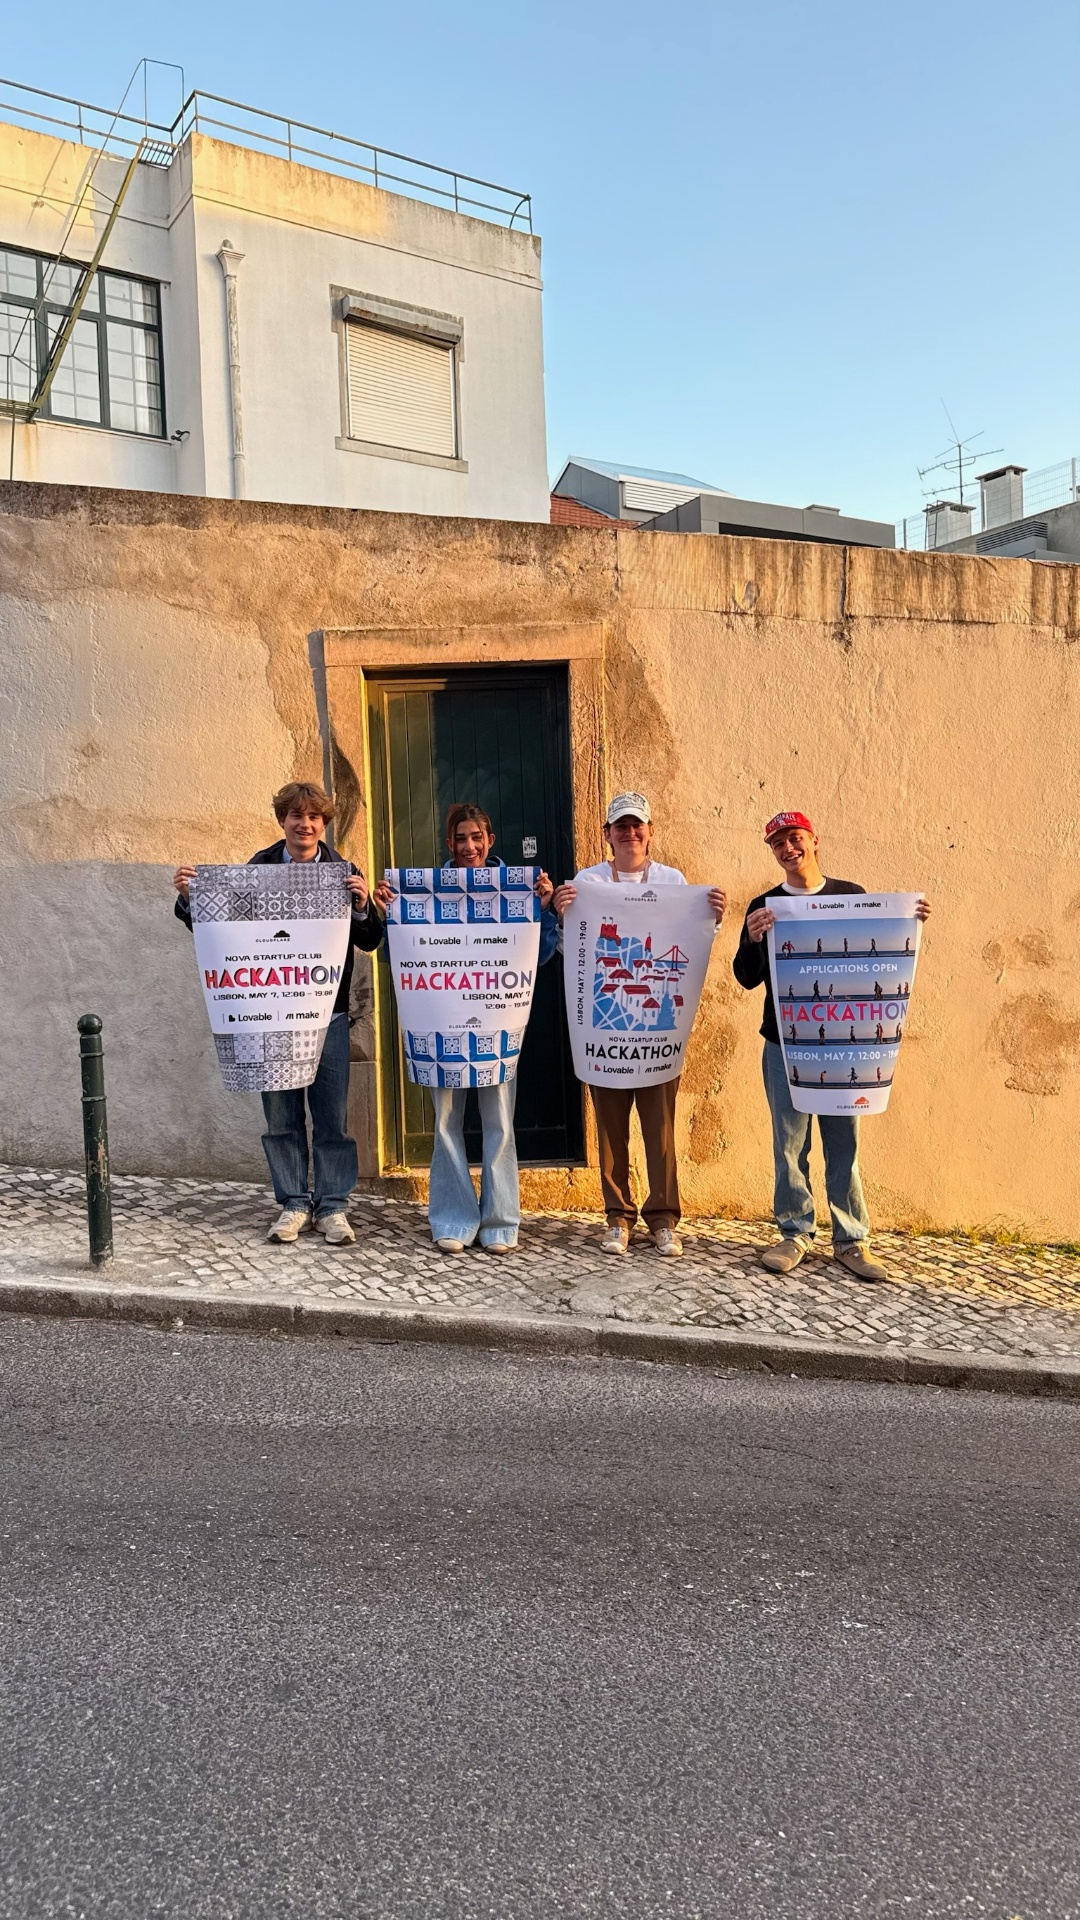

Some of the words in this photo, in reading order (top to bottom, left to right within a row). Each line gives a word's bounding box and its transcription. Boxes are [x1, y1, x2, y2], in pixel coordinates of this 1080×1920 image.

[429, 937, 461, 945] Lovable
[483, 936, 508, 944] make
[430, 960, 478, 968] STARTUP
[799, 963, 870, 974] APPLICATIONS
[872, 963, 898, 973] OPEN
[205, 965, 341, 989] HACKATHON
[400, 970, 533, 991] HACKATHON
[213, 993, 247, 1001] LISBON,
[462, 993, 503, 1001] LISBON,
[238, 1013, 273, 1022] Lovable
[295, 1011, 320, 1019] make
[585, 1041, 682, 1060] HACKATHON
[787, 1051, 821, 1061] LISBON,
[823, 1051, 845, 1061] MAY
[847, 1051, 855, 1061] 7,
[858, 1051, 881, 1060] 12:00
[603, 1065, 635, 1074] Lovable
[652, 1063, 672, 1073] make
